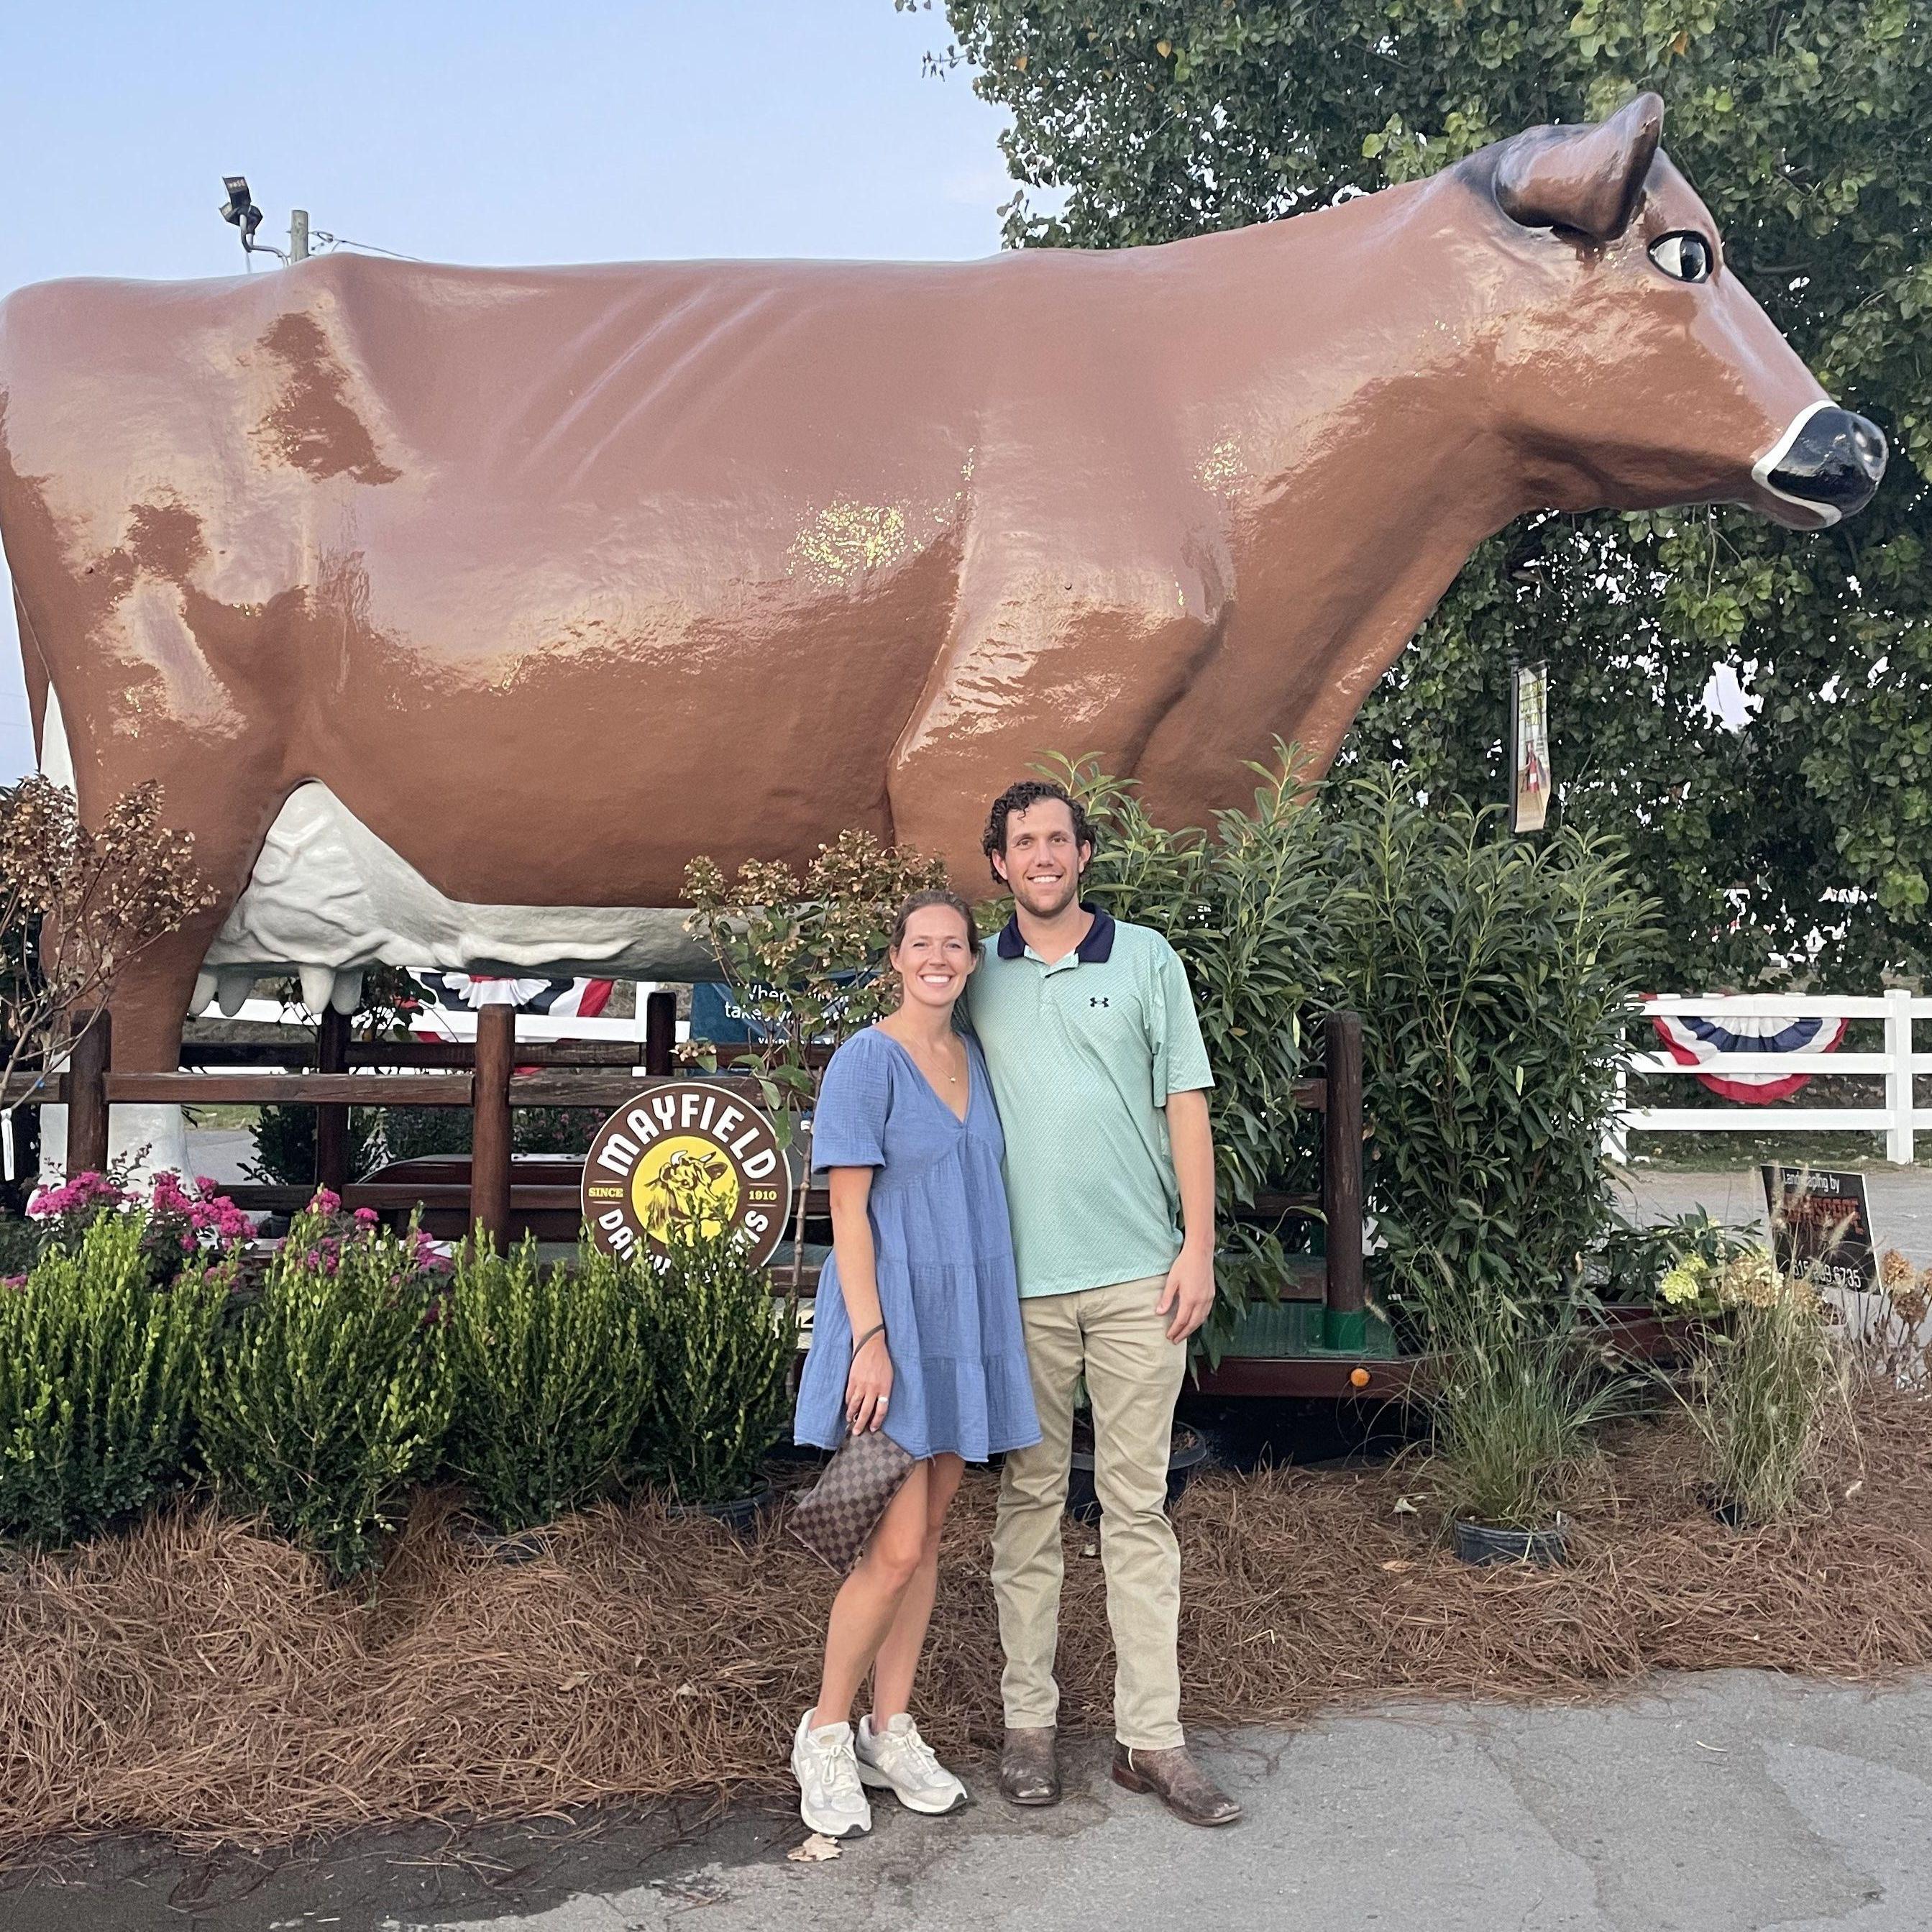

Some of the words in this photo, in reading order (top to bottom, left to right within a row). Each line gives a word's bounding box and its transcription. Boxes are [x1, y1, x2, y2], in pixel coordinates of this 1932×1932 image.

[596, 1093, 777, 1179] MAYFIELD
[588, 1186, 624, 1199] SINCE
[1829, 1174, 1840, 1194] by
[748, 1190, 777, 1201] 1910
[598, 1208, 672, 1276] DAIY
